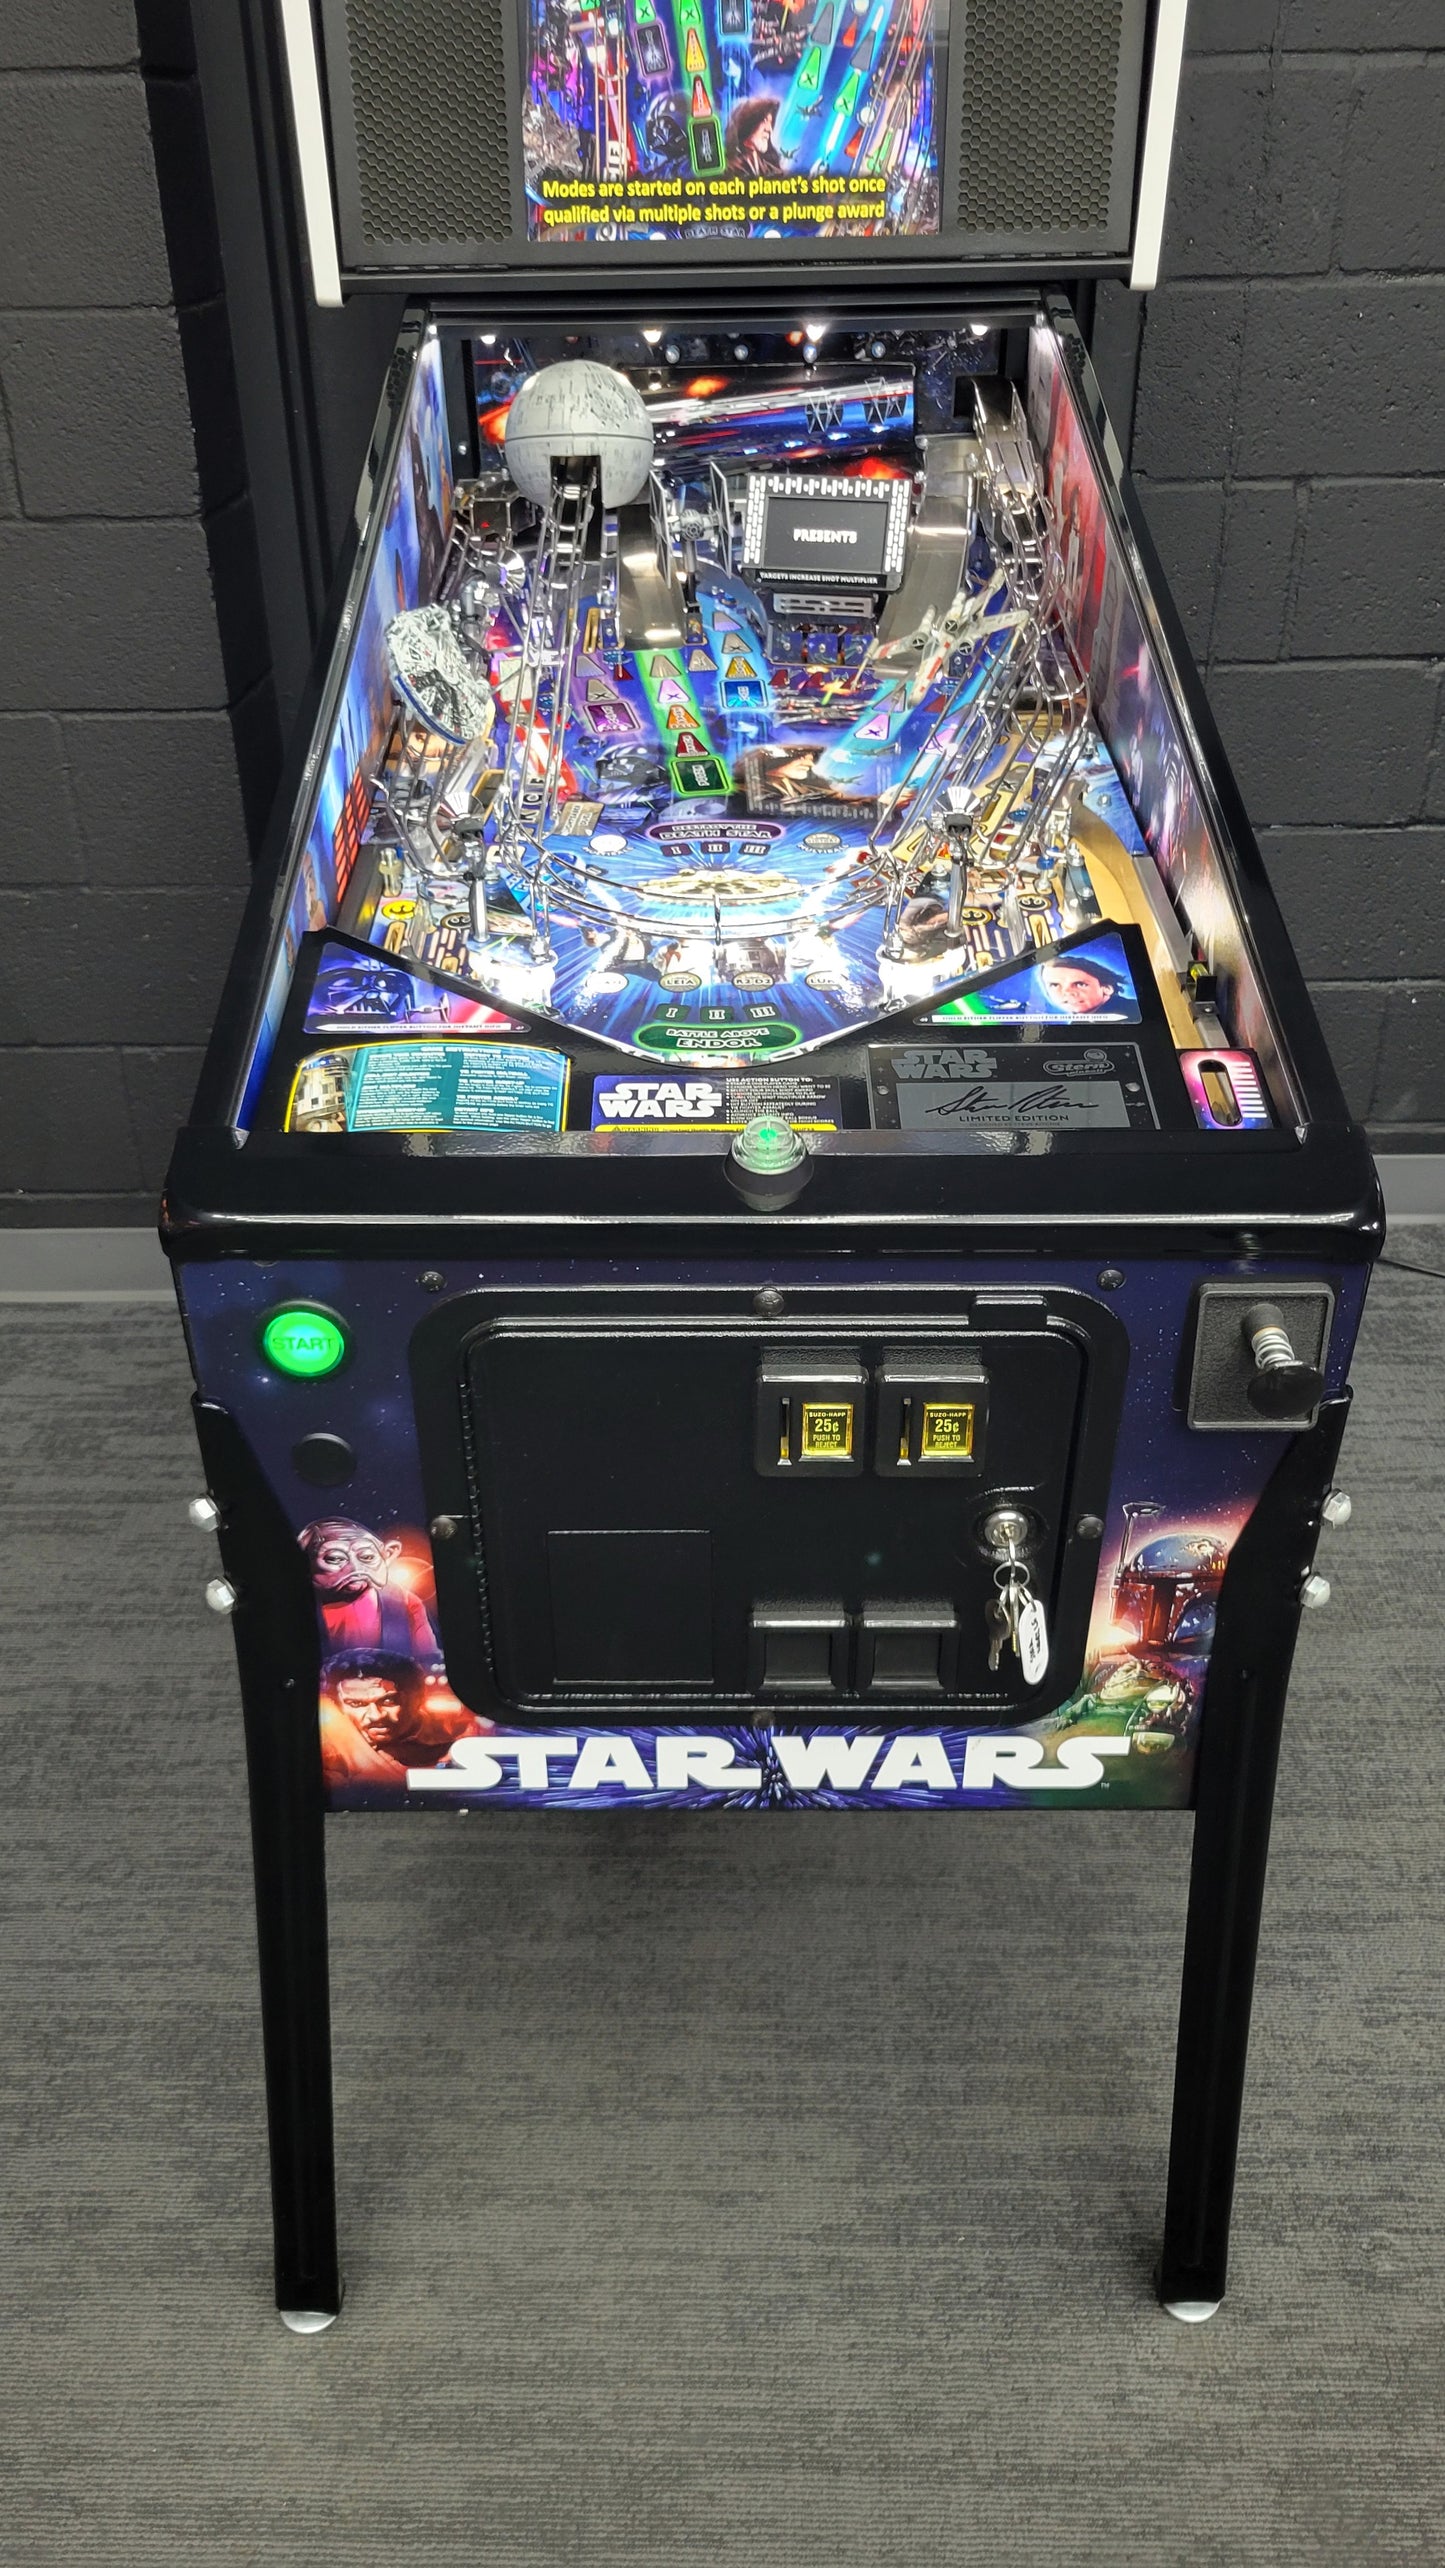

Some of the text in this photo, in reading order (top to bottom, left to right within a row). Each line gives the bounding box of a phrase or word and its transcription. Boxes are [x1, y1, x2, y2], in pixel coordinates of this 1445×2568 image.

[542, 175, 886, 199] Modes are started on each planet's shot once
[543, 201, 885, 226] qualified via multiple shots or a plunge award
[793, 528, 857, 544] PRESENTS
[760, 572, 878, 585] TARGETS INCREASE SHOT MULTIPLIER
[659, 830, 772, 840] DEATH STAR
[708, 1009, 725, 1019] II
[750, 1006, 776, 1018] III
[666, 1027, 770, 1038] BATTLE ABOVE
[676, 1038, 762, 1049] ENDOR
[891, 1050, 997, 1064] STAR
[891, 1063, 998, 1079] WARS
[1050, 1061, 1110, 1073] Stern
[599, 1083, 722, 1101] STAR
[599, 1099, 722, 1118] WARS
[272, 1337, 336, 1351] START
[814, 1418, 839, 1433] 25¢
[934, 1418, 959, 1433] 25¢
[932, 1434, 961, 1442] PUSH TO
[407, 1736, 763, 1791] STAR
[765, 1736, 1132, 1791] WARS
